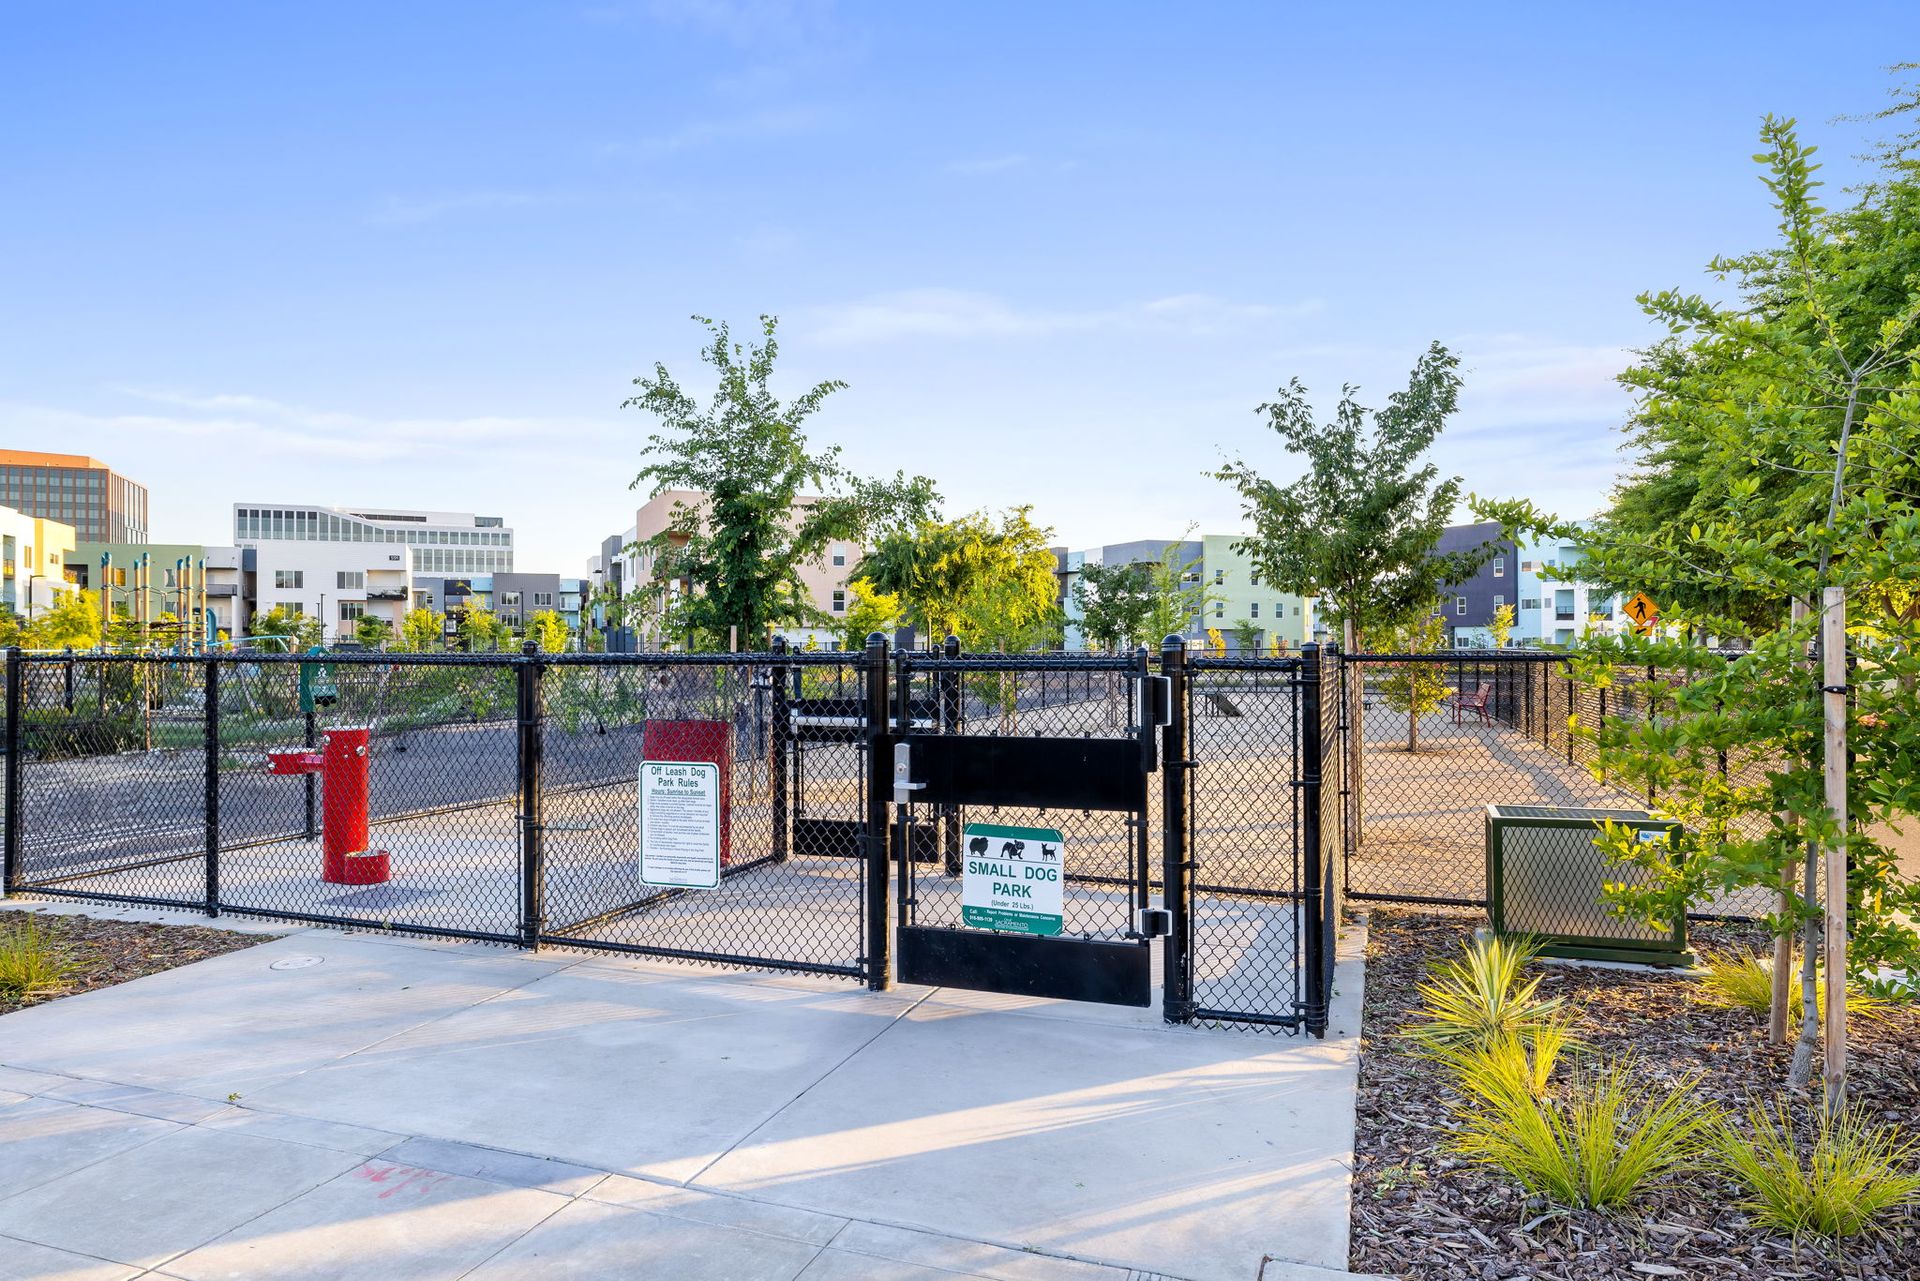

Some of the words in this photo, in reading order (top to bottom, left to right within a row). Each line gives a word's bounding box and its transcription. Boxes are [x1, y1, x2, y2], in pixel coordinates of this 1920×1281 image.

[651, 766, 662, 775] Off
[665, 767, 687, 776] Leash
[691, 767, 706, 778] Dog
[658, 777, 675, 787] Park
[678, 778, 699, 788] Rules
[969, 861, 1017, 878] SMALL
[1025, 866, 1058, 882] DOG
[993, 882, 1032, 898] PARK
[991, 899, 1010, 907] (Under
[1019, 902, 1034, 910] Lbs.)
